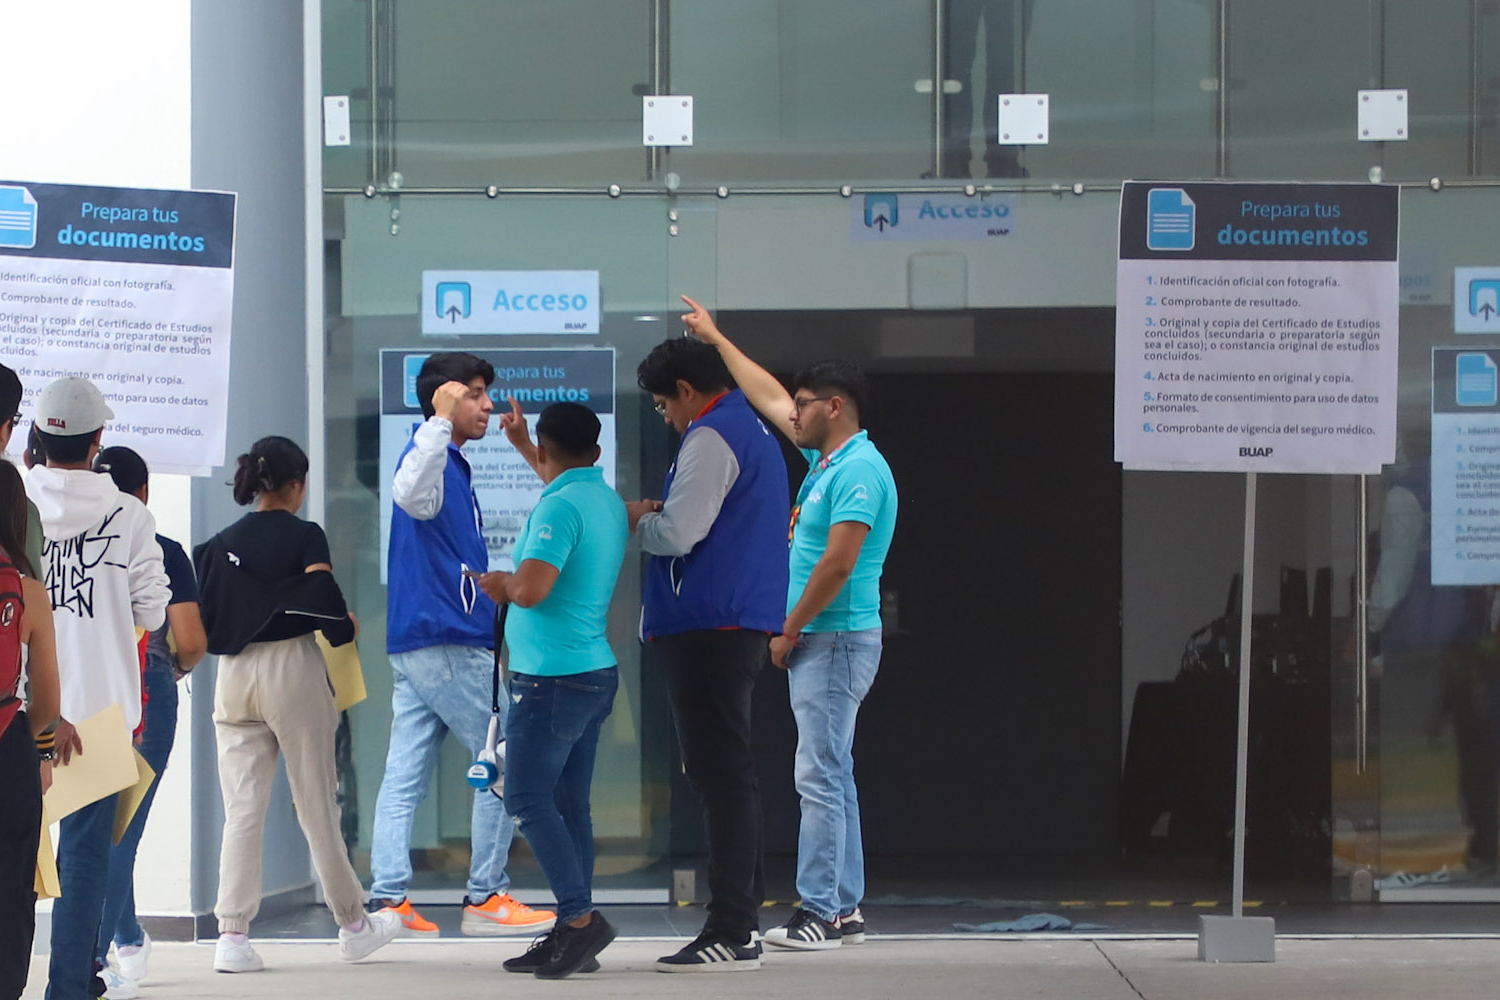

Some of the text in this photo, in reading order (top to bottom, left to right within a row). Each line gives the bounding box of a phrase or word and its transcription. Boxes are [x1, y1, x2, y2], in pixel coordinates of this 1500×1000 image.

[81, 202, 180, 224] Prepara tus
[918, 200, 1010, 220] Acceso
[1241, 201, 1341, 221] Prepara tus
[57, 224, 205, 253] documentos
[1217, 224, 1369, 246] documentos
[0, 272, 68, 285] Identificación
[70, 276, 100, 287] oficial
[103, 280, 121, 288] con
[123, 278, 176, 292] fotografía.
[1147, 275, 1340, 289] 1. Identificación oficial con fotografía.
[0, 292, 70, 305] Comprobante
[71, 296, 84, 306] de
[86, 298, 137, 309] resultado.
[492, 289, 588, 311] Acceso
[1145, 296, 1301, 308] 2. Comprobante de resultado.
[40, 317, 47, 325] y
[49, 316, 76, 328] copia
[79, 317, 94, 327] del
[97, 318, 152, 330] Certificado
[155, 321, 167, 331] de
[171, 323, 213, 334] Estudios
[1145, 317, 1380, 329] 3. Original y copia del Certificado de Estudios
[41, 327, 99, 338] (secundaria
[115, 332, 178, 343] preparatoria
[182, 334, 212, 345] según
[1144, 329, 1380, 341] concluidos (secundaria o preparatoria según
[2, 335, 12, 344] el
[14, 336, 44, 347] caso);
[56, 339, 110, 350] constancia
[112, 341, 151, 353] original
[154, 344, 166, 353] de
[169, 344, 211, 355] estudios
[1144, 340, 1380, 353] sea el caso); o constancia original de estudios
[1144, 351, 1202, 361] concluidos.
[19, 367, 31, 377] de
[91, 372, 104, 380] en
[106, 372, 144, 384] original
[146, 376, 153, 385] y
[154, 375, 185, 386] copia.
[495, 365, 565, 382] repara tus
[1143, 371, 1354, 385] 4. Acta de nacimiento en original y copia.
[125, 394, 147, 404] para
[149, 396, 166, 404] uso
[167, 395, 180, 405] de
[181, 396, 208, 406] datos
[488, 385, 590, 402] cumentos
[1143, 391, 1379, 405] 5. Formato de consentimiento para uso de datos
[1143, 403, 1199, 414] personales.
[114, 423, 130, 432] del
[131, 425, 164, 436] seguro
[166, 425, 204, 436] médico.
[1142, 422, 1375, 436] 6. Comprobante de vigencia del seguro médico.
[1239, 447, 1274, 457] BUAP
